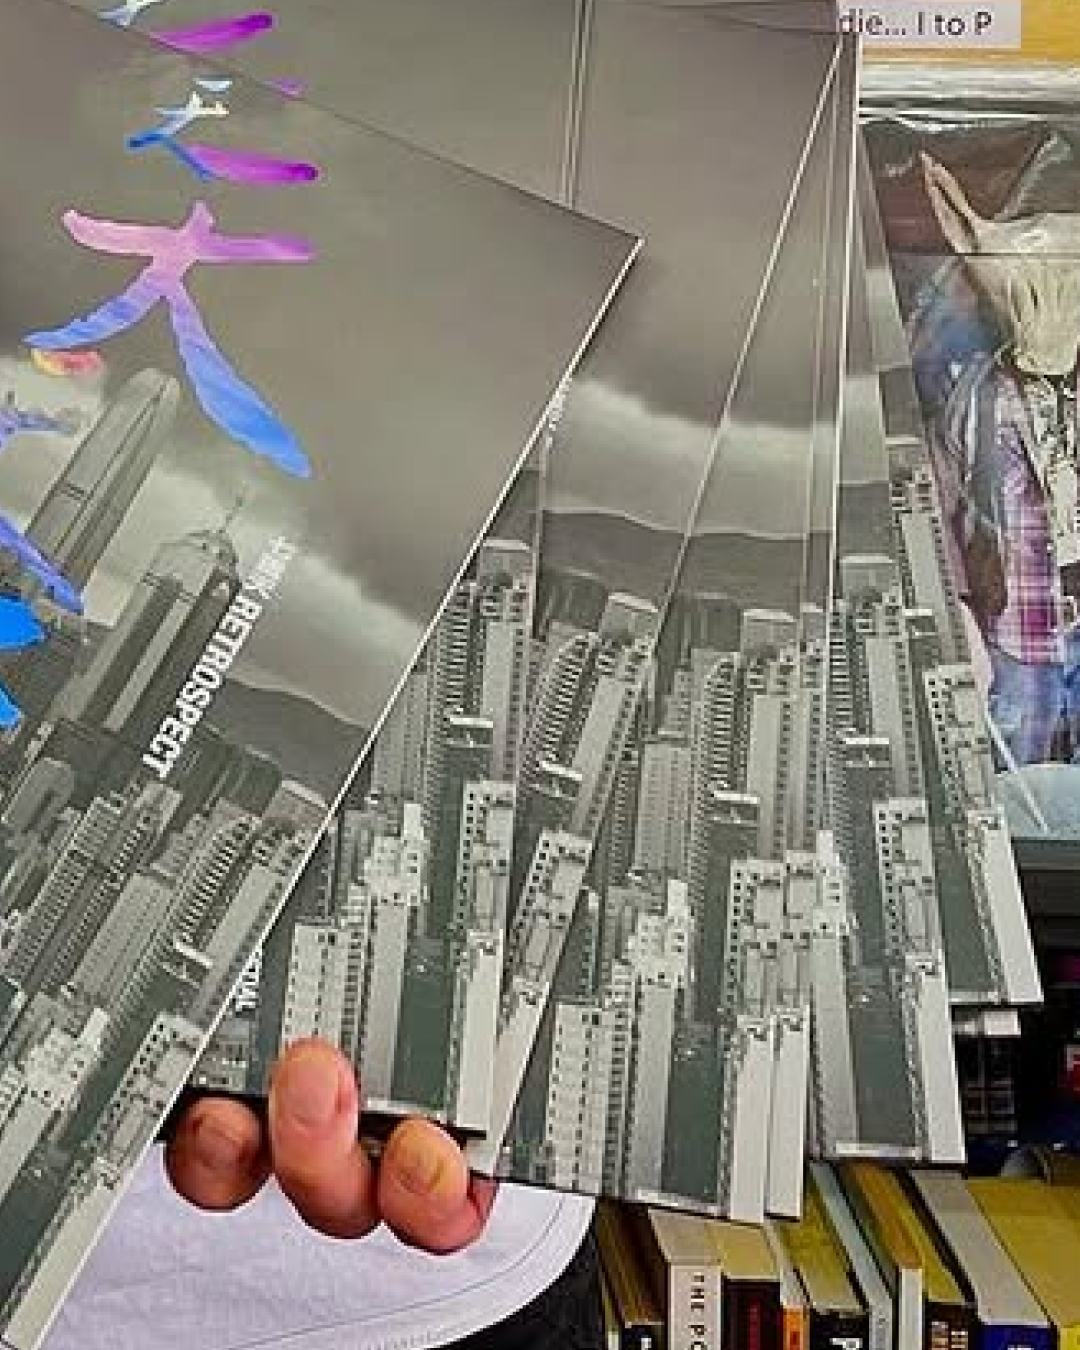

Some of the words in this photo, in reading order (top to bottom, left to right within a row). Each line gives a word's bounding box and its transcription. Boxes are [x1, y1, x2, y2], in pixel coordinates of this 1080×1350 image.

[934, 13, 966, 36] to
[974, 10, 992, 36] P
[142, 593, 263, 779] RETROSPECT
